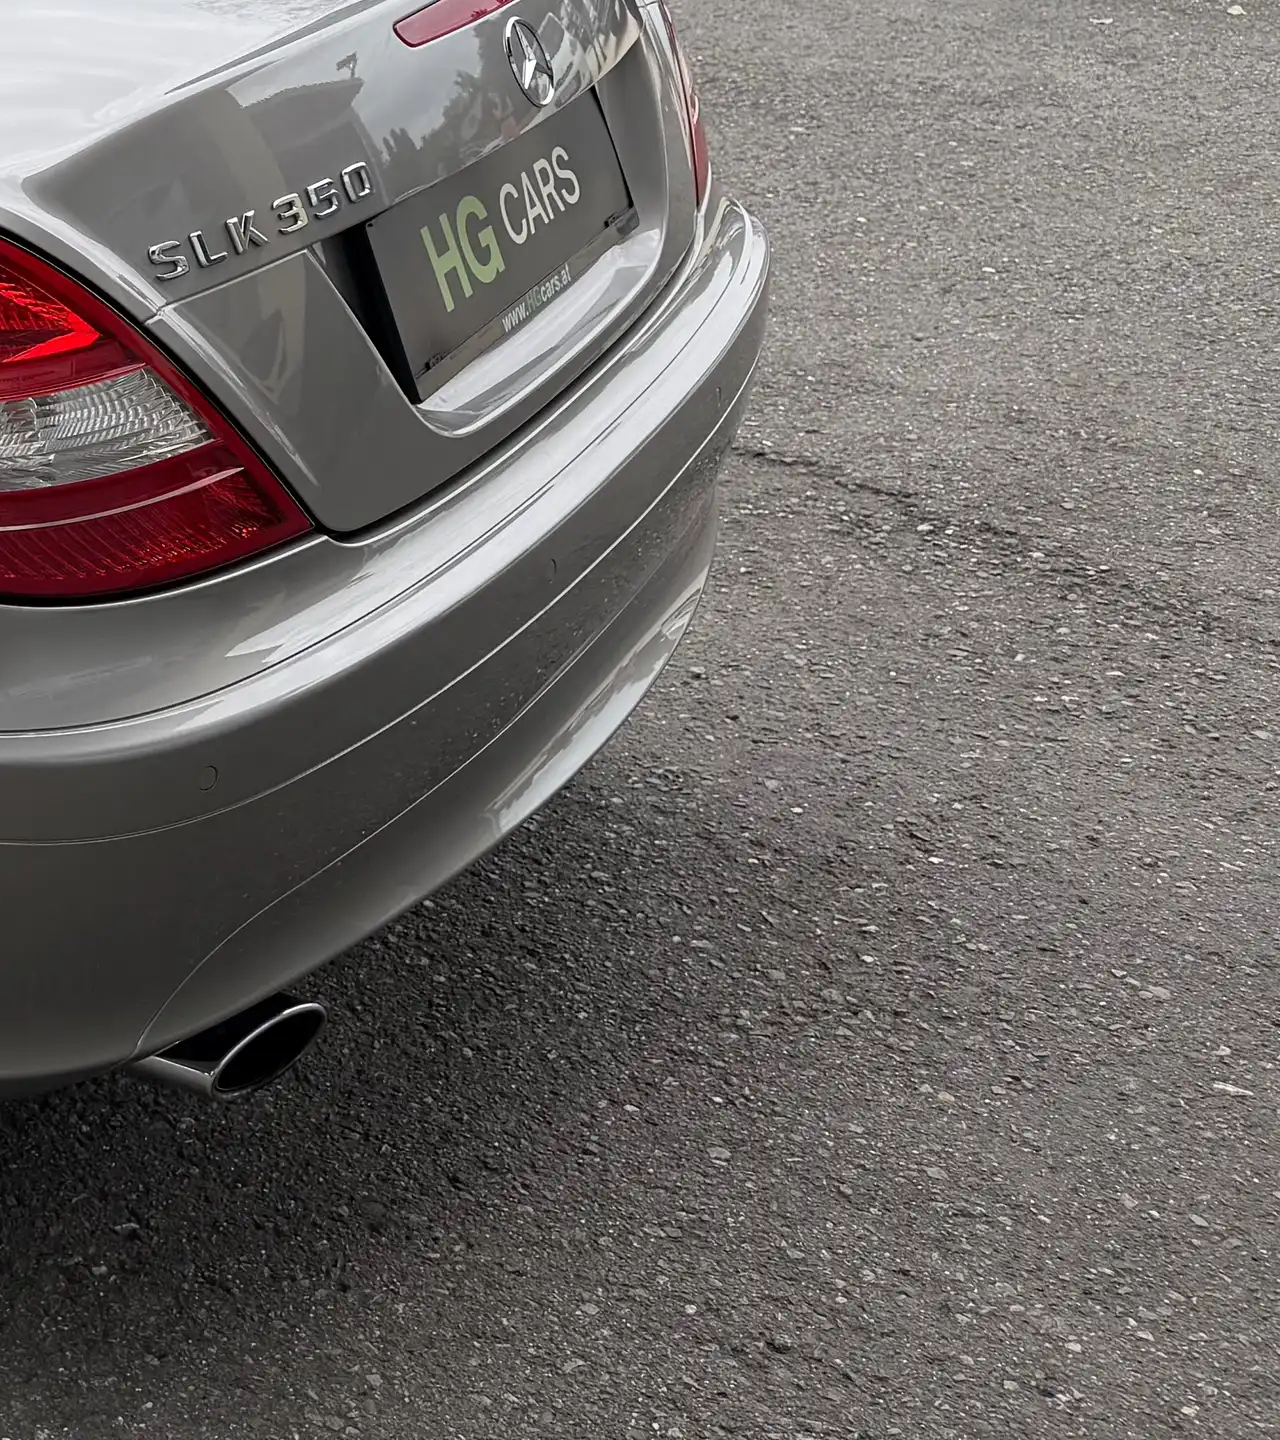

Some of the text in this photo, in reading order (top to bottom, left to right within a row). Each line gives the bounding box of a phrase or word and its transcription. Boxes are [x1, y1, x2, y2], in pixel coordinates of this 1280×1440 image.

[147, 161, 372, 282] SLK 350
[421, 146, 581, 313] HG CARS
[500, 262, 572, 334] www.HGcars.at
